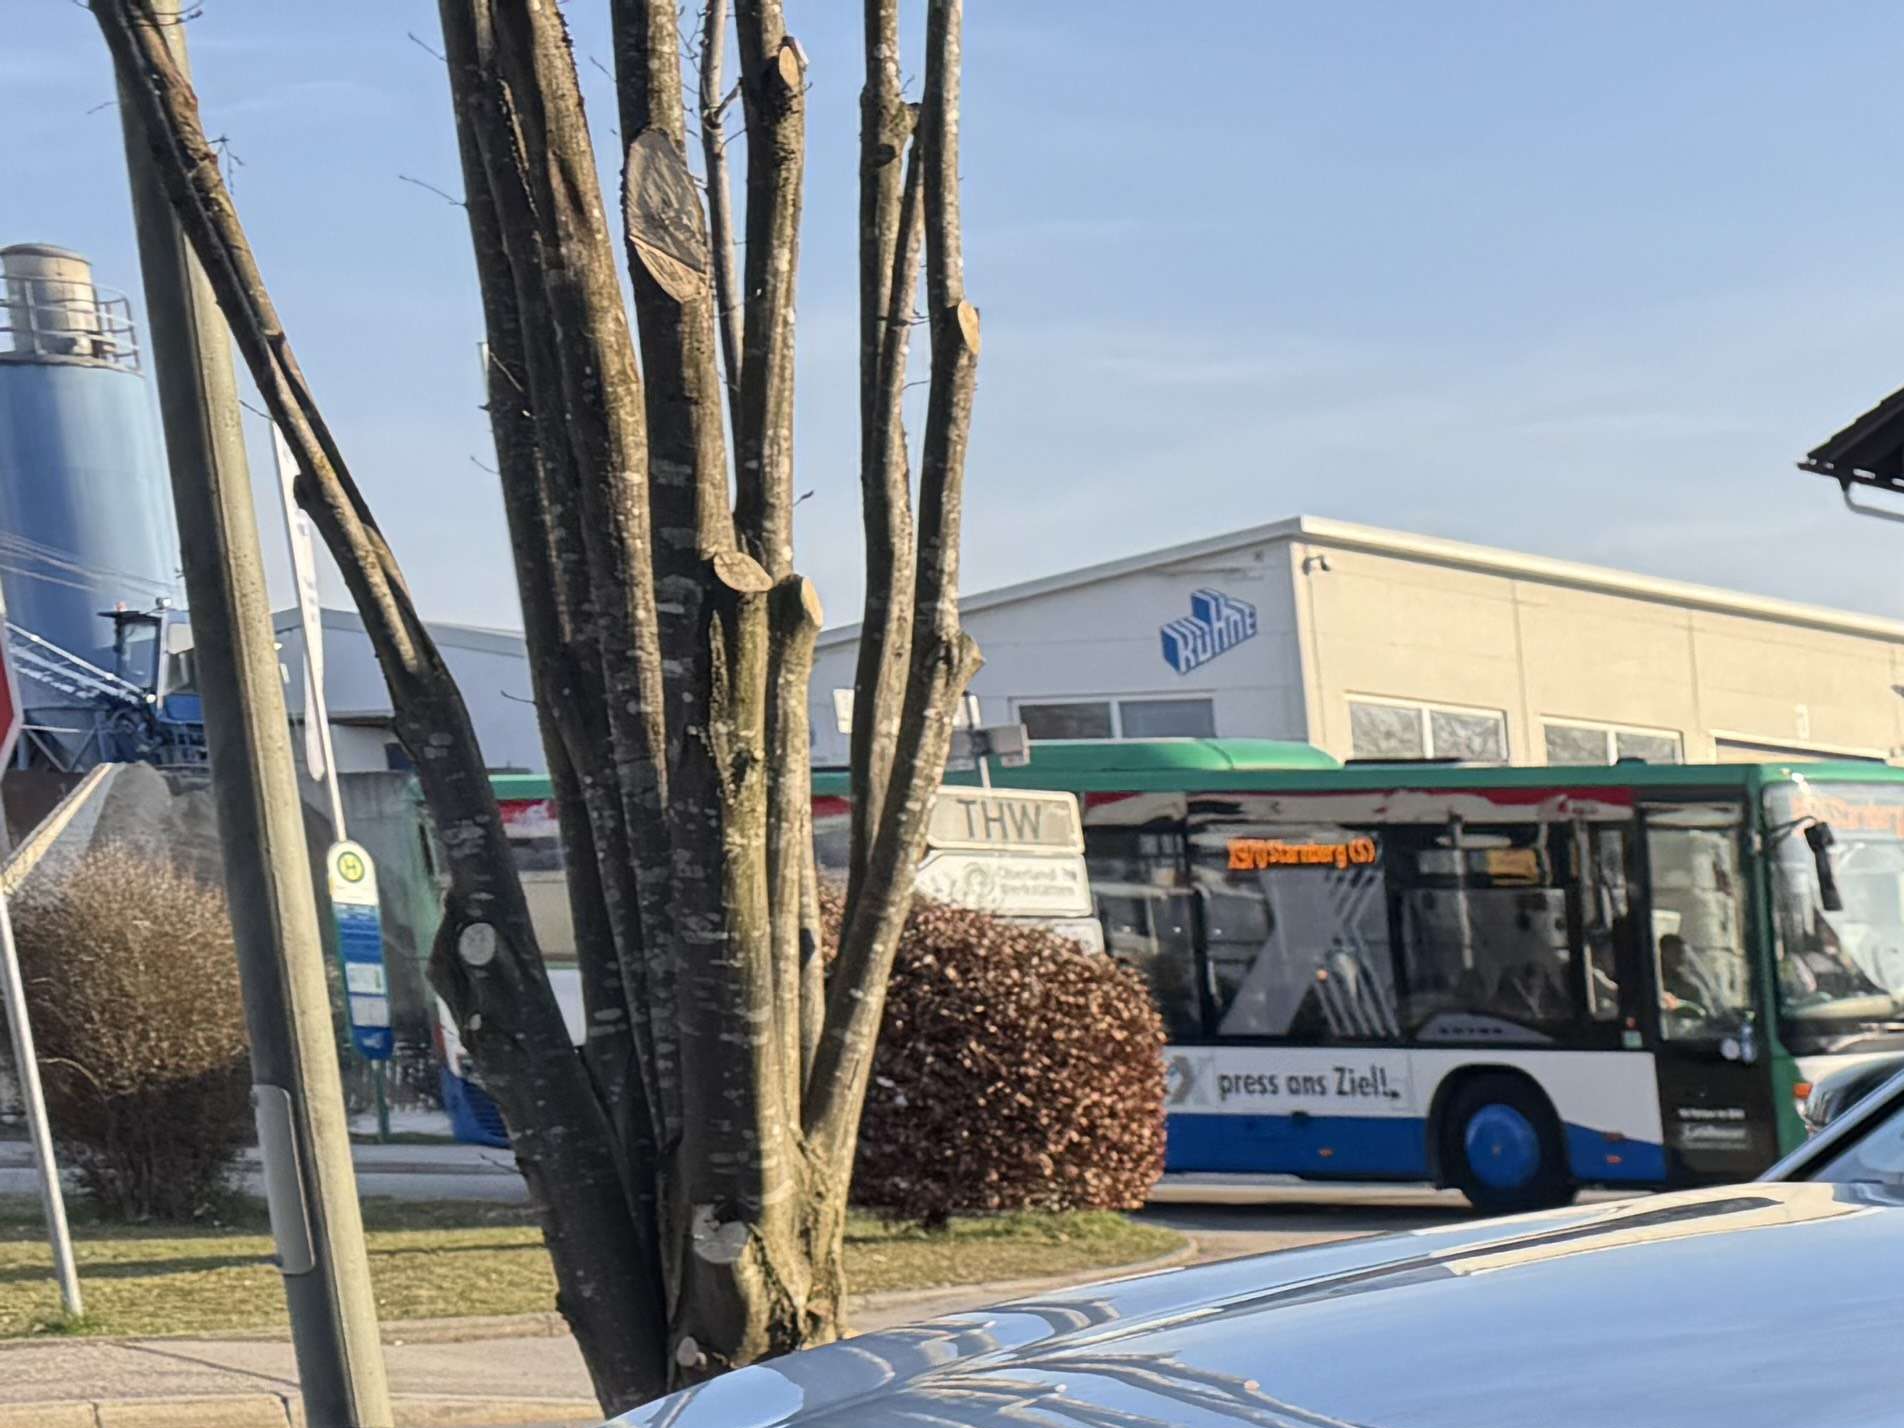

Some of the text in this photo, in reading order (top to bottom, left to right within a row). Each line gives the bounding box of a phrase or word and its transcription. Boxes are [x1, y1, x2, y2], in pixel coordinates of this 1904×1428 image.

[957, 799, 1041, 840] THW
[1217, 1073, 1279, 1101] press
[1286, 1073, 1327, 1096] ans
